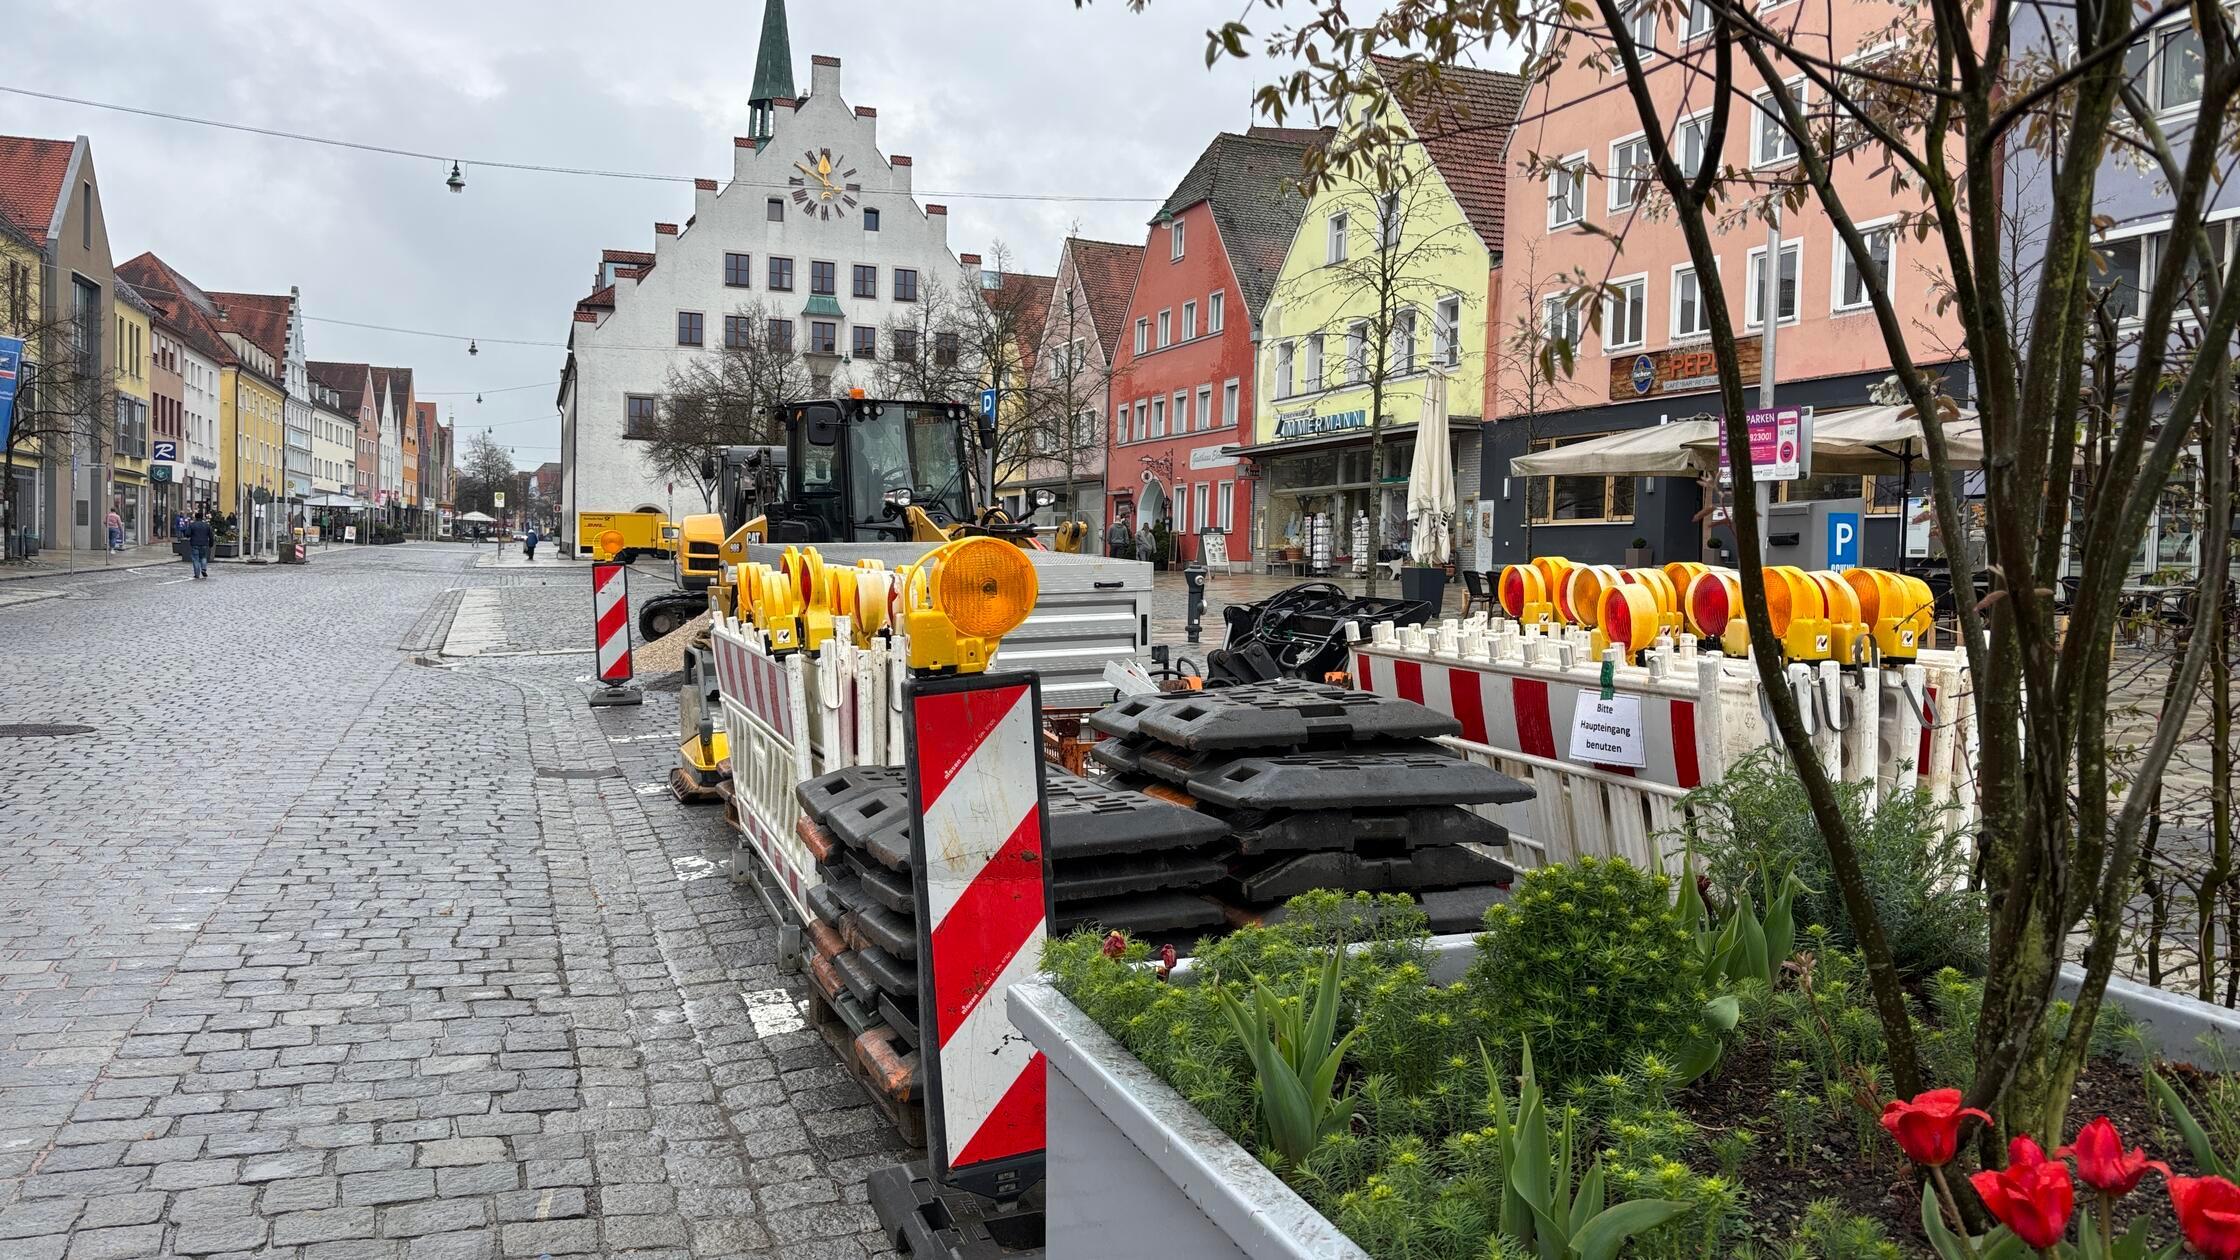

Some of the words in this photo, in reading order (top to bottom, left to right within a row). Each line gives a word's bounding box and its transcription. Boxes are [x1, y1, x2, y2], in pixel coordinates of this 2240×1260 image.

[1273, 410, 1362, 438] ZIMMERMANN
[746, 531, 761, 545] CAT
[1836, 522, 1854, 556] P
[1597, 703, 1613, 714] Bitte
[1581, 720, 1631, 737] Haupteingang
[1586, 739, 1622, 753] benutzen
